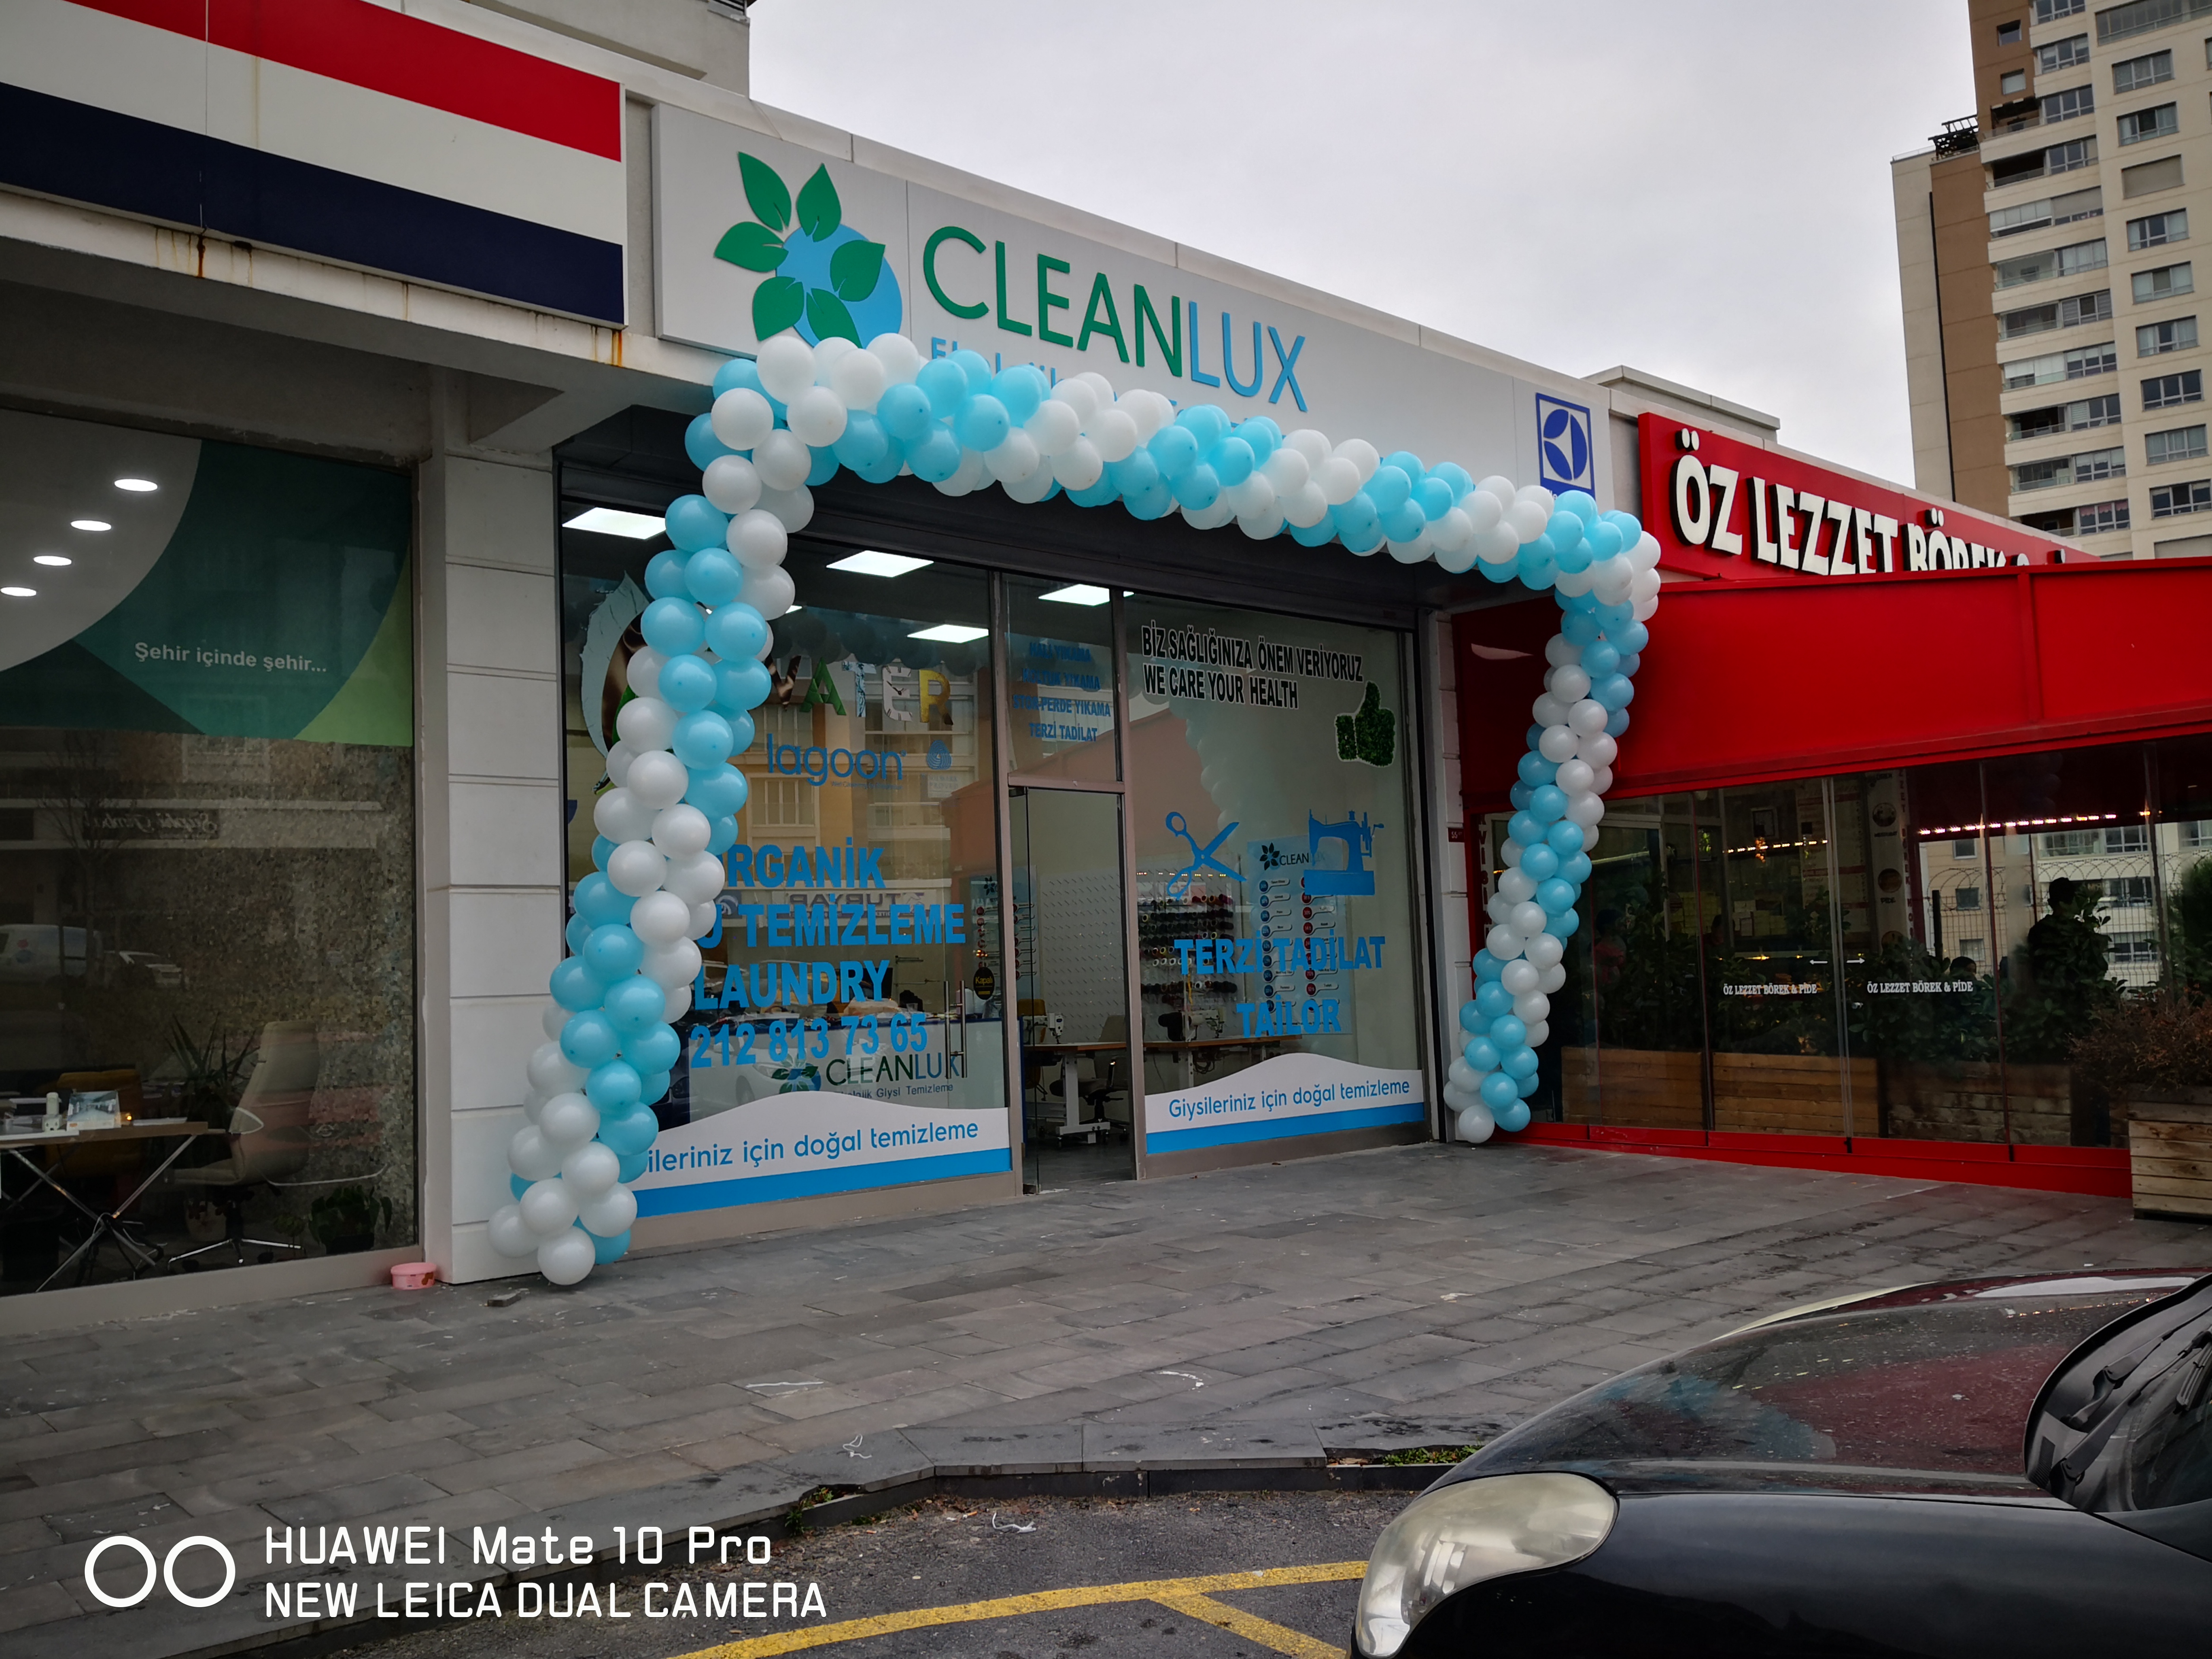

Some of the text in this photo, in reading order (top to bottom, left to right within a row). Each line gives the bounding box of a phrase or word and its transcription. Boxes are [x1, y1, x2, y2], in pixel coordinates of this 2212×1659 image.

[923, 226, 1308, 412] CLEANLUX
[1675, 427, 1743, 556] ÖZ
[1751, 477, 1898, 575] LEZZET
[134, 642, 327, 673] Şehir içinde şehir...
[1142, 620, 1363, 682] BİZ SAĞLIĞINIZA ÖNEM VERİYORUZ
[1075, 699, 1111, 717] YIKAMA
[1143, 663, 1299, 709] WE CARE YOUR HEALTH
[1029, 721, 1098, 742] TERZİ TADİLAT
[717, 836, 886, 889] RGANİK
[738, 893, 966, 948] TEMİZLEME
[1174, 928, 1386, 975] TERZİ TADİLAT
[694, 960, 890, 1010] LAUNDRY
[1723, 982, 1818, 995] ÖZ LEZZET BÖREK & PİDE
[1867, 979, 1974, 994] ÖZ LEZZET BÖREK & PİDE
[1236, 995, 1341, 1038] TAİLOR
[690, 1013, 928, 1069] 212 813 73 65
[906, 1084, 953, 1095] Temizleme
[1169, 1078, 1410, 1121] Giysileriniz için doğal temizleme
[648, 1120, 979, 1173] ileriniz için doğal temizleme
